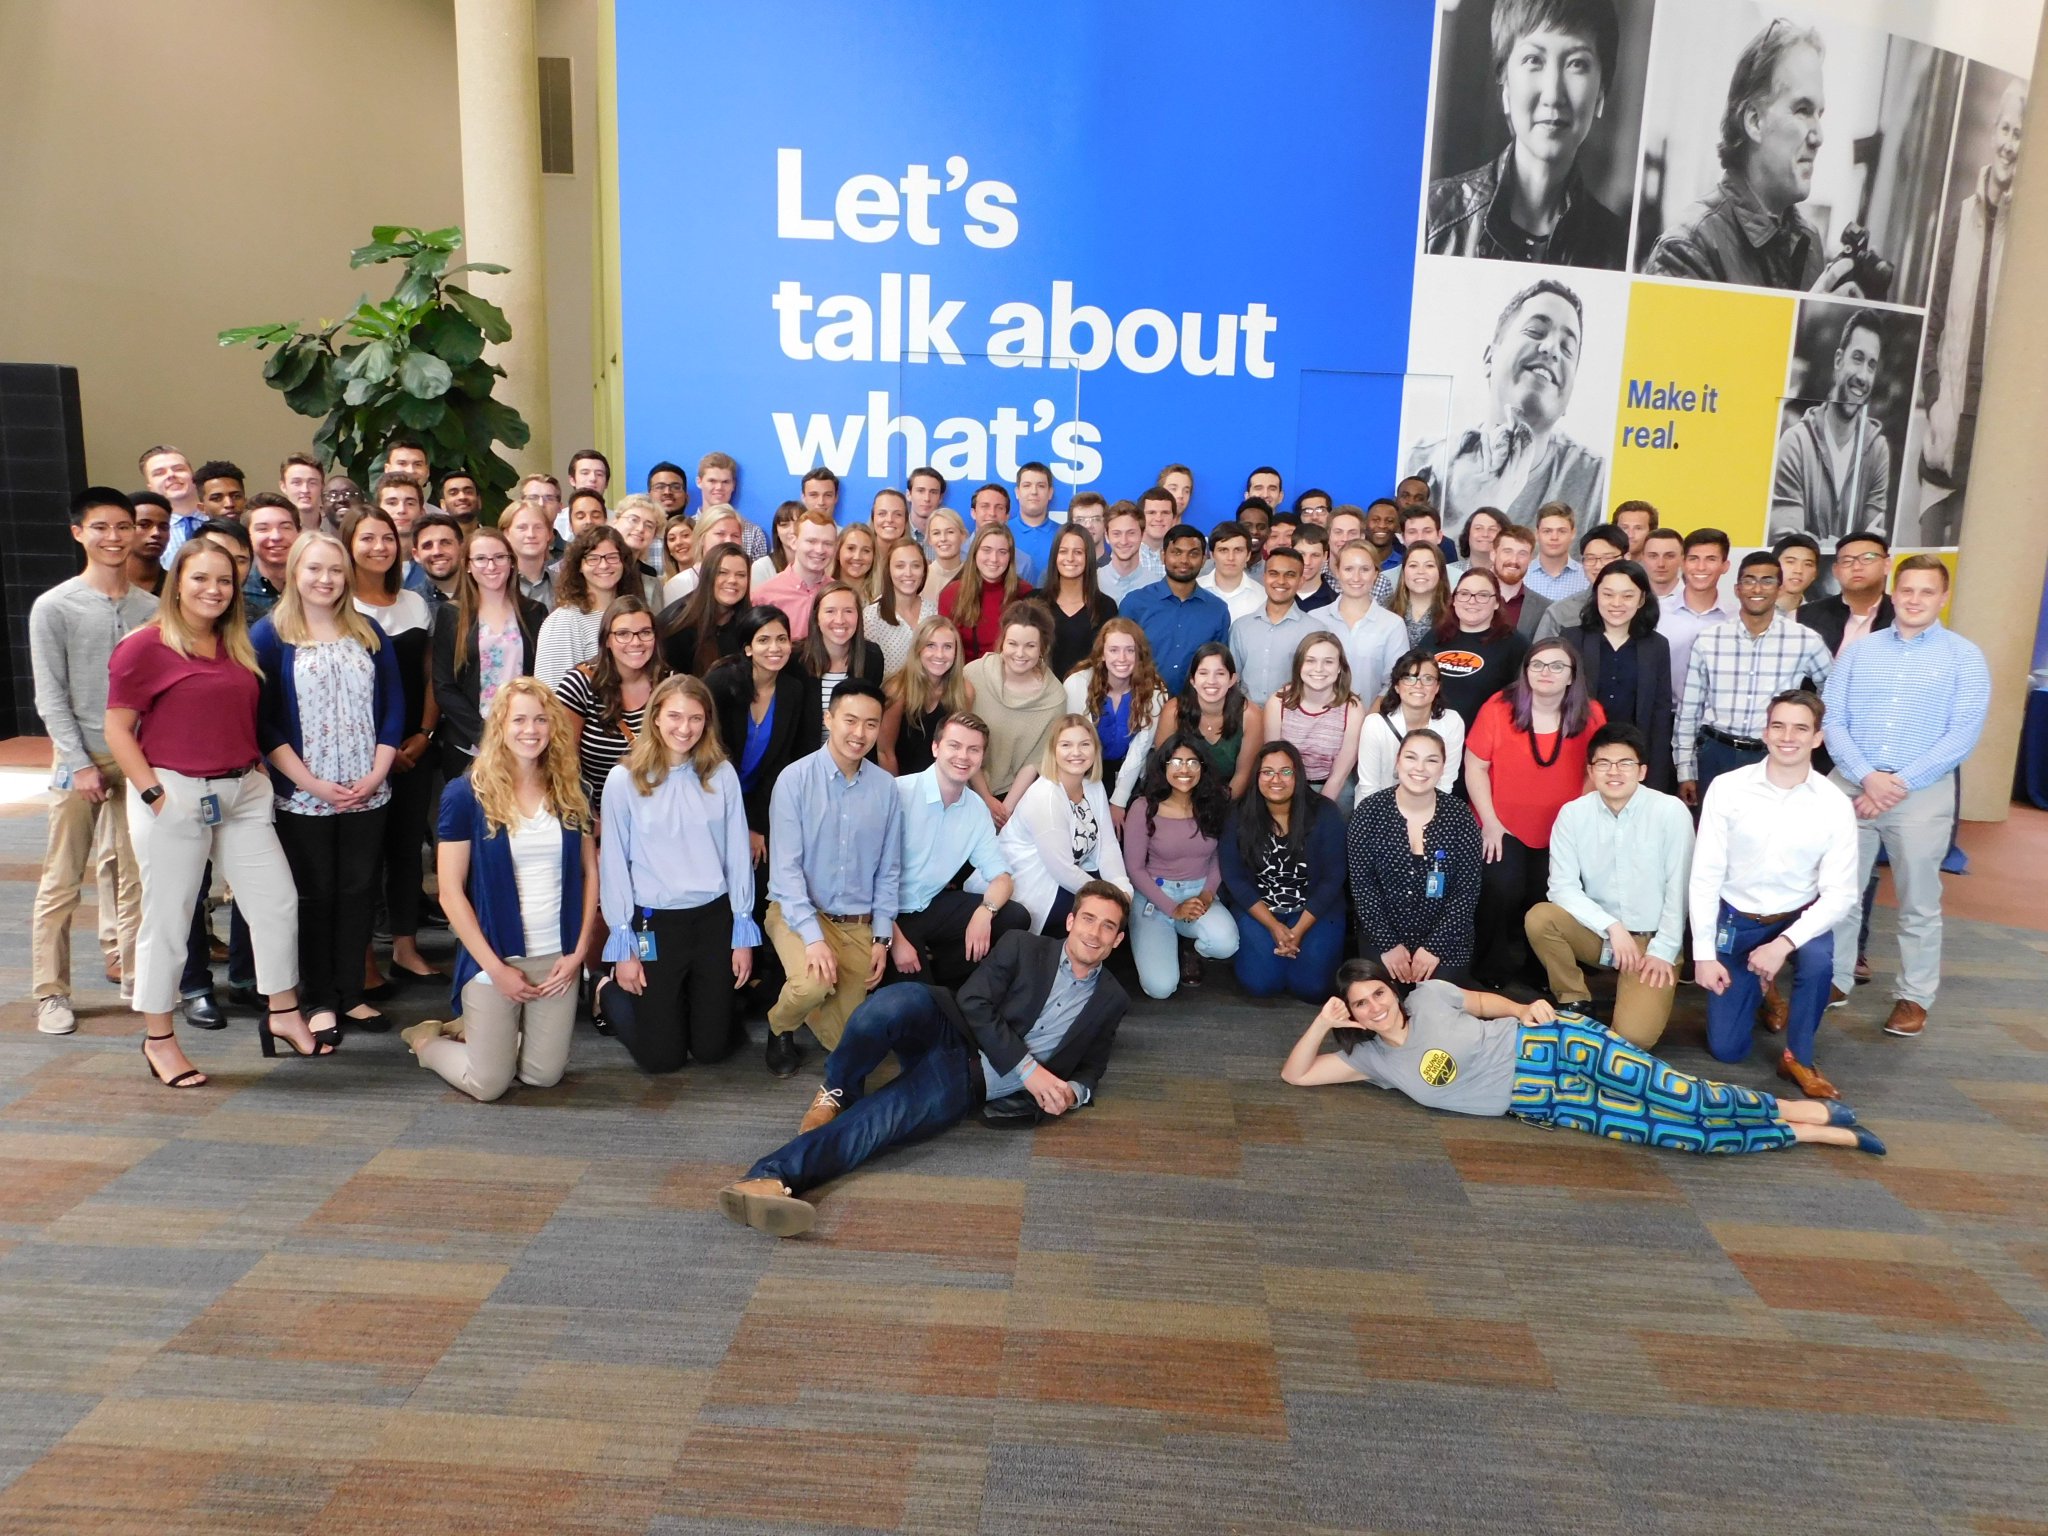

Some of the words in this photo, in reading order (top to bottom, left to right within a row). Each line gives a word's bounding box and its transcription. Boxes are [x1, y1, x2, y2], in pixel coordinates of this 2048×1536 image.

[776, 148, 1019, 249] Let's
[772, 273, 967, 366] talk
[987, 280, 1278, 379] about
[1627, 379, 1696, 412] Make
[1701, 384, 1718, 413] it
[771, 390, 1103, 485] what's
[1622, 420, 1679, 450] real.
[1423, 1053, 1440, 1075] SOUND
[1426, 1073, 1435, 1083] OF
[1431, 1053, 1447, 1075] MUSIC
